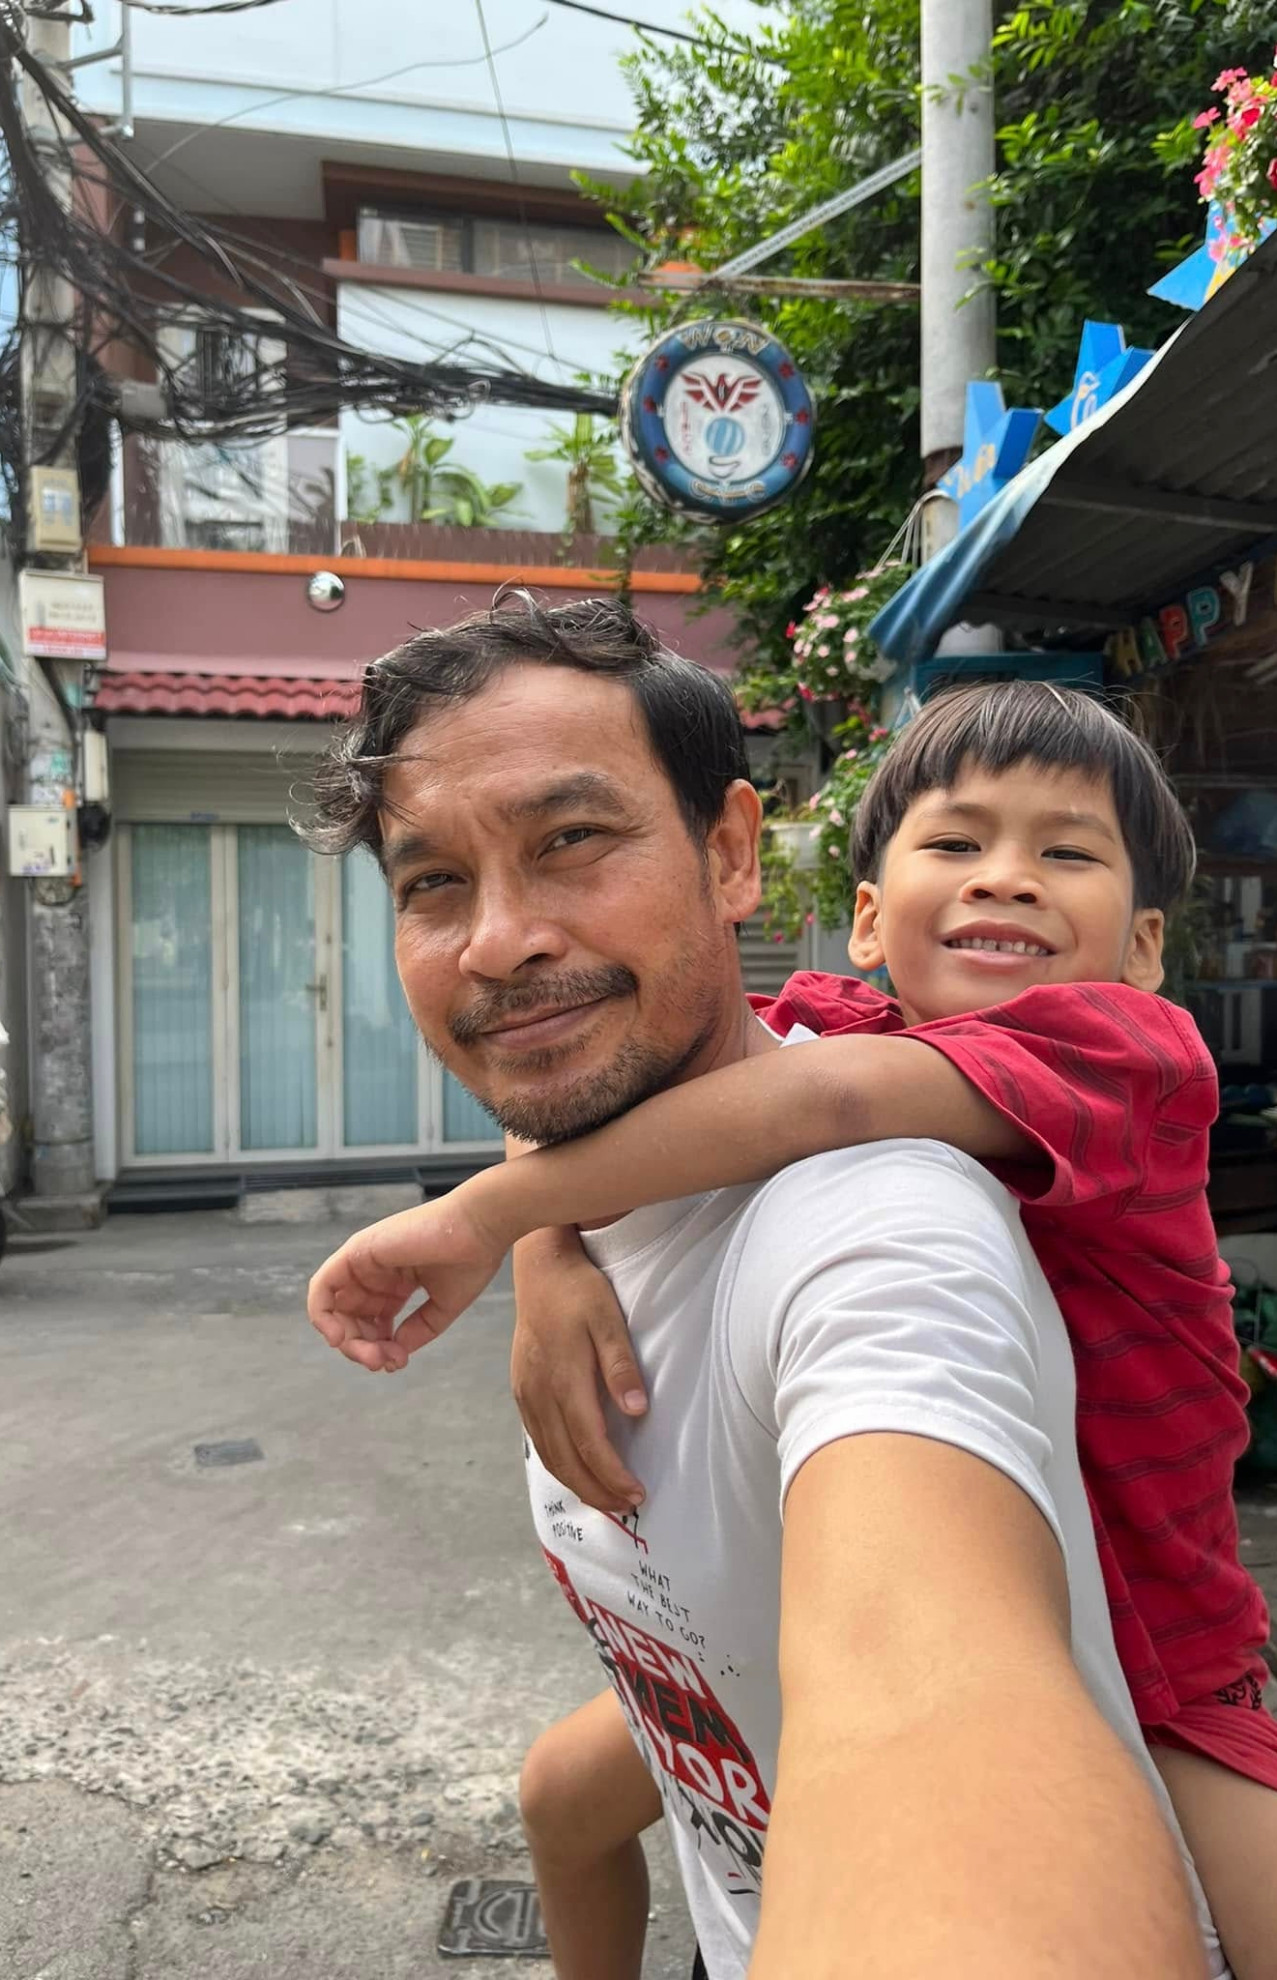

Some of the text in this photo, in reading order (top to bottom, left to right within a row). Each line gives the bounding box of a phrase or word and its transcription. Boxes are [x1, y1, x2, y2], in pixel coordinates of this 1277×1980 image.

[1105, 561, 1254, 677] HAPPY
[544, 1501, 567, 1517] THINK
[552, 1519, 584, 1542] POSITIVE
[631, 1573, 691, 1622] THE BEST
[638, 1560, 671, 1592] WHAT
[627, 1590, 649, 1617] WAY
[655, 1611, 675, 1632] TO
[591, 1603, 708, 1699] NEW
[644, 1715, 769, 1826] YOR
